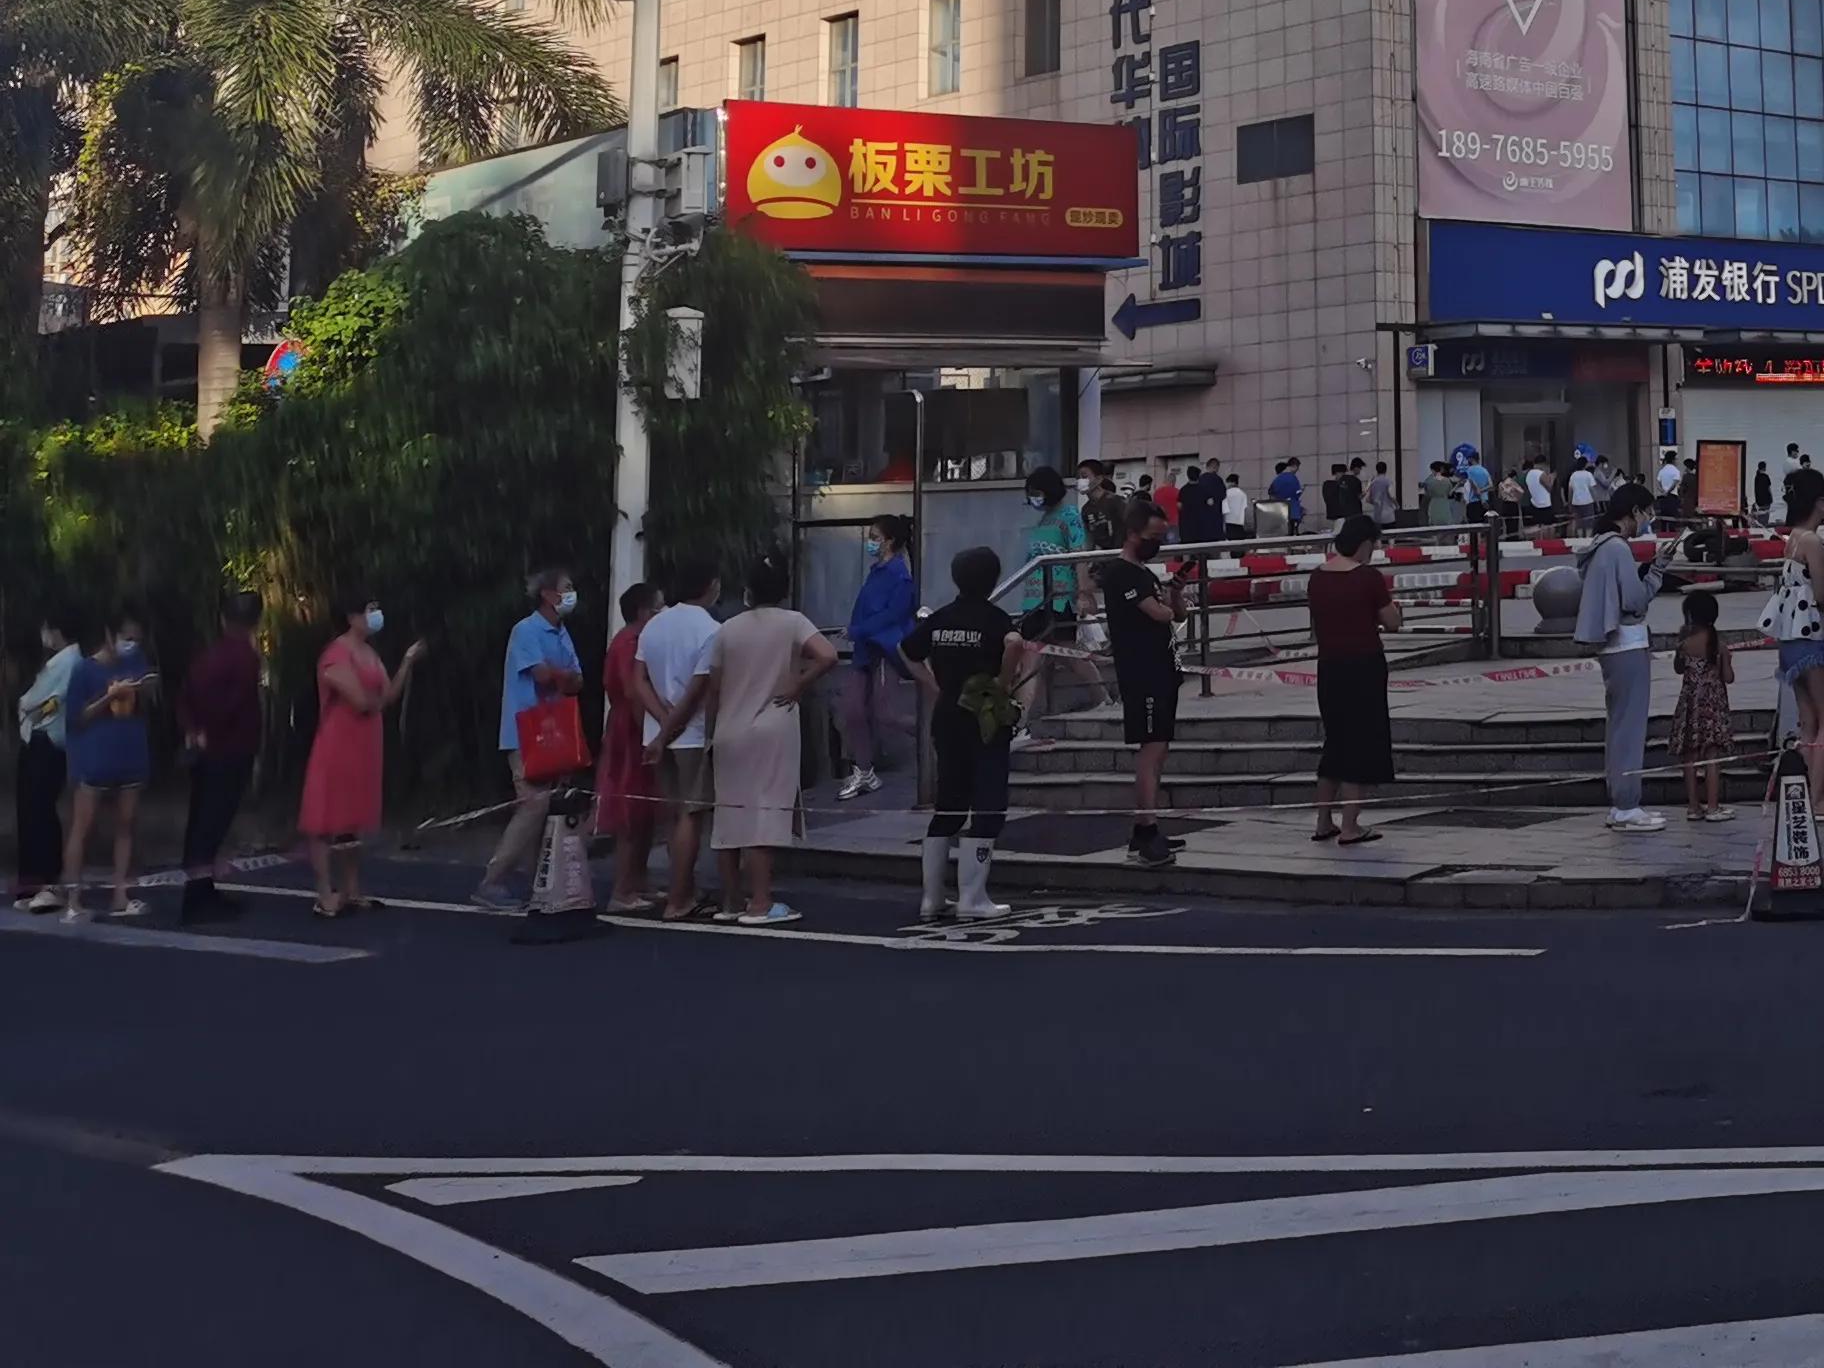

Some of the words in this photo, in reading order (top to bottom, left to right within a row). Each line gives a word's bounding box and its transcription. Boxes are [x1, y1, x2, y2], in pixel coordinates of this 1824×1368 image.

[849, 138, 1055, 200] 板栗工坊
[1159, 40, 1202, 291] 国际影城
[1437, 129, 1614, 172] 189-7685-5955
[850, 206, 891, 221] BAN
[902, 209, 921, 222] LI
[931, 210, 989, 224] GONG
[999, 211, 1050, 225] FANG
[1658, 255, 1781, 305] 浦发银行
